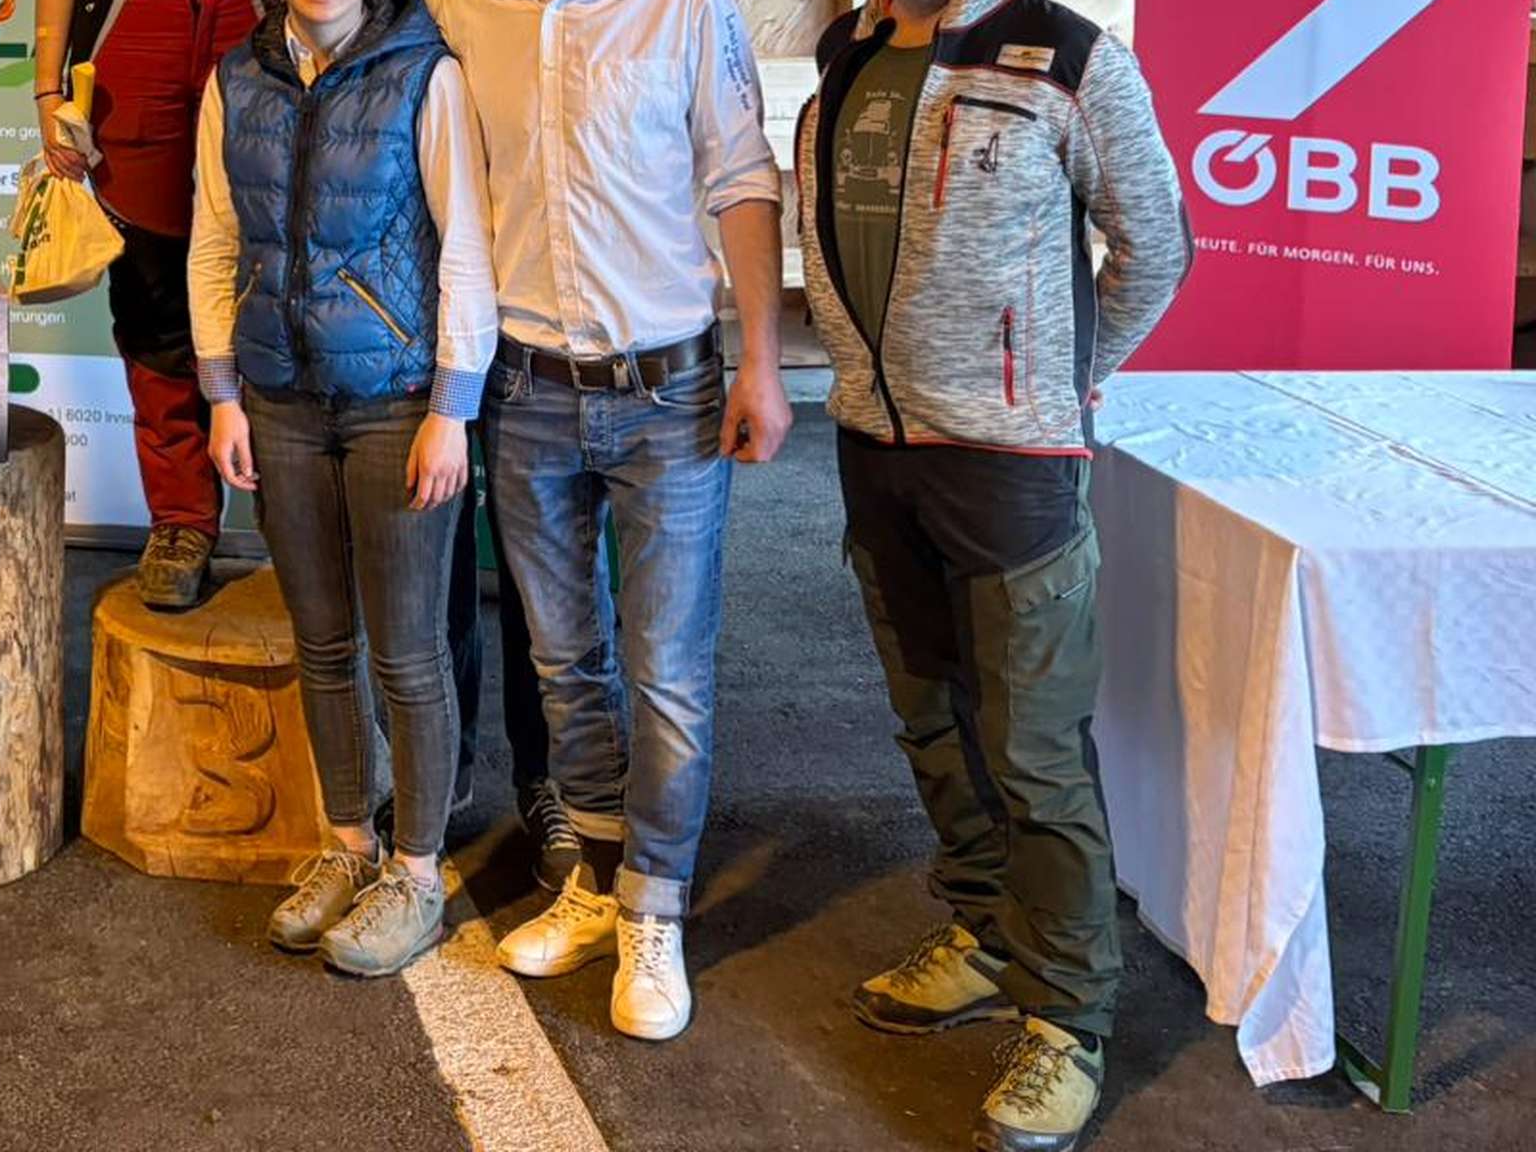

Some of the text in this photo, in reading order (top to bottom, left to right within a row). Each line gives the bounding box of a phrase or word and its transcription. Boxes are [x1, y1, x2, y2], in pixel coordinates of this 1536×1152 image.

[1191, 129, 1441, 223] ÖBB
[1248, 240, 1279, 258] FÜR
[1283, 244, 1359, 266] MORGEN.
[1365, 253, 1396, 271] FÜR
[1401, 259, 1440, 276] UNS.
[66, 408, 103, 424] 6020
